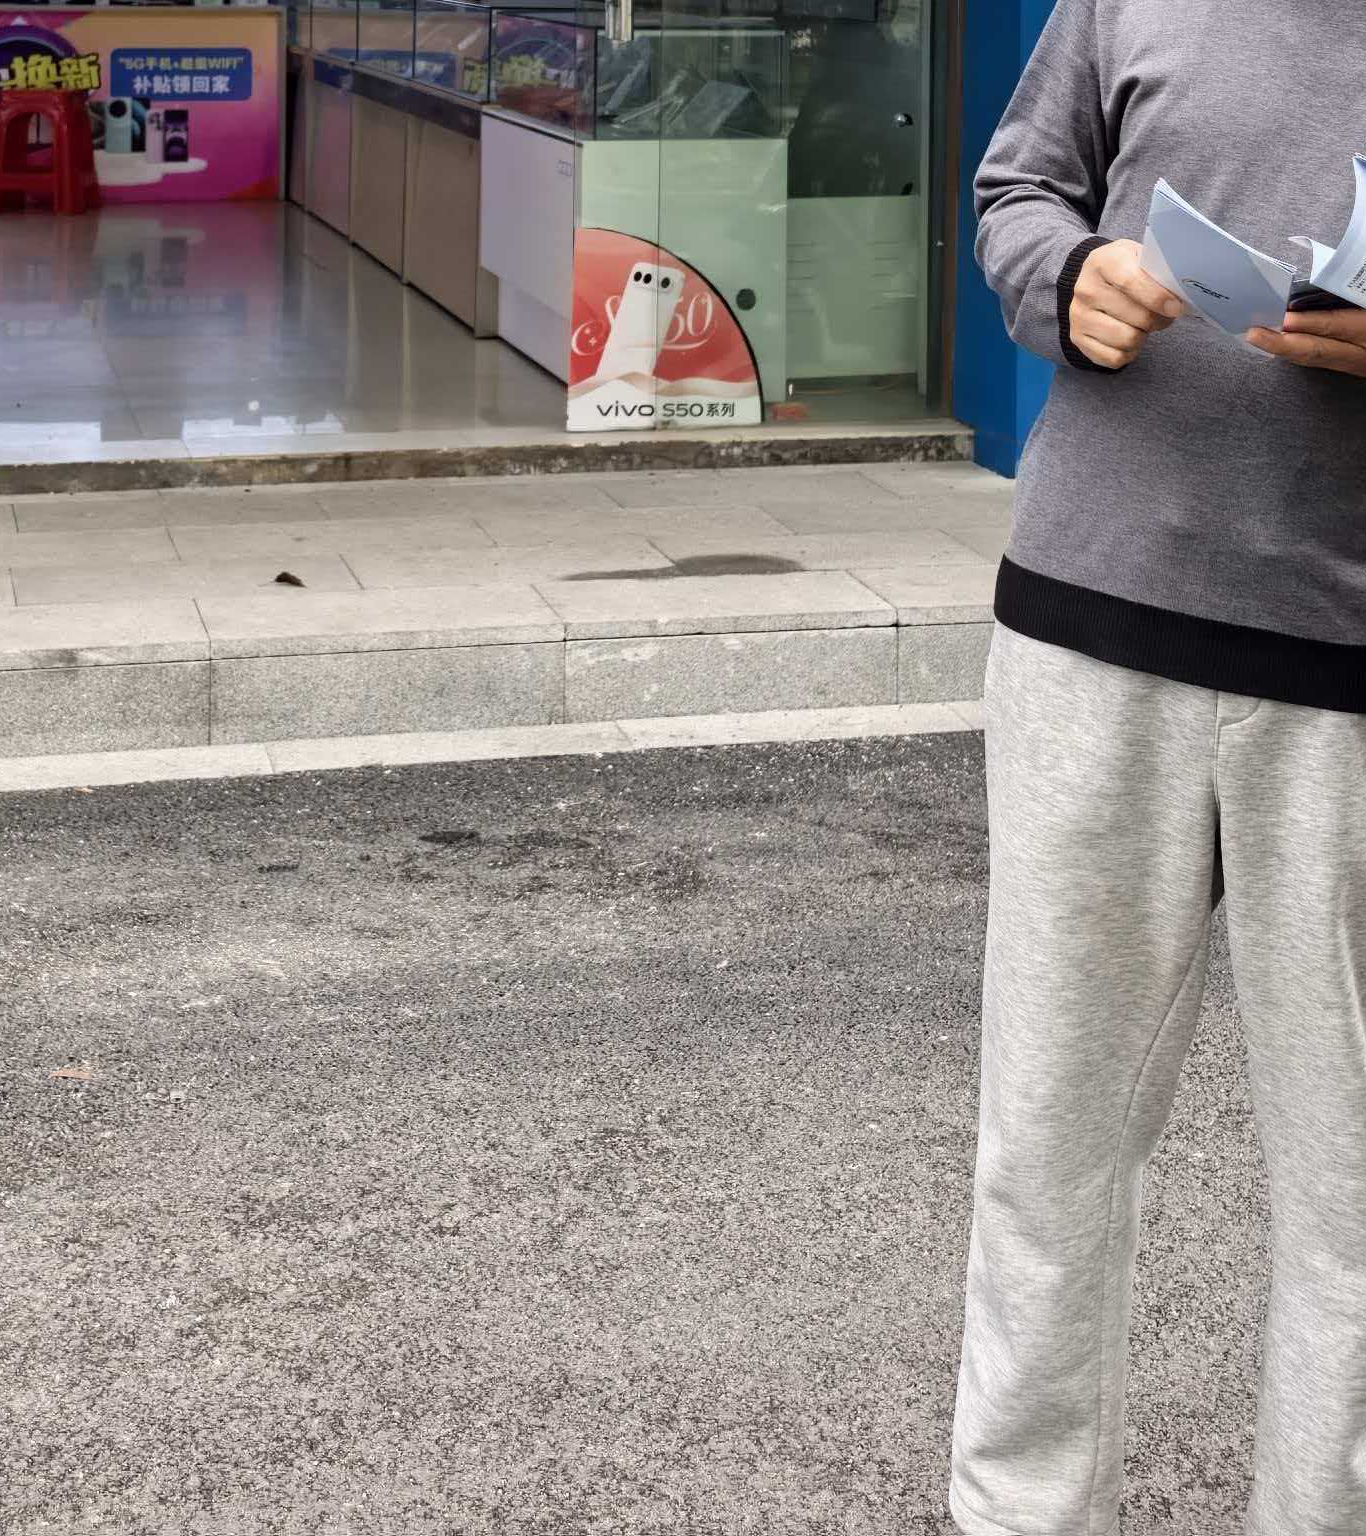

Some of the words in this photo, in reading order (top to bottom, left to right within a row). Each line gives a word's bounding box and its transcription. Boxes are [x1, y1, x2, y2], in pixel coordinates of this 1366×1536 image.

[596, 400, 655, 417] vivo
[662, 402, 704, 418] S50
[706, 401, 736, 418] 系列
